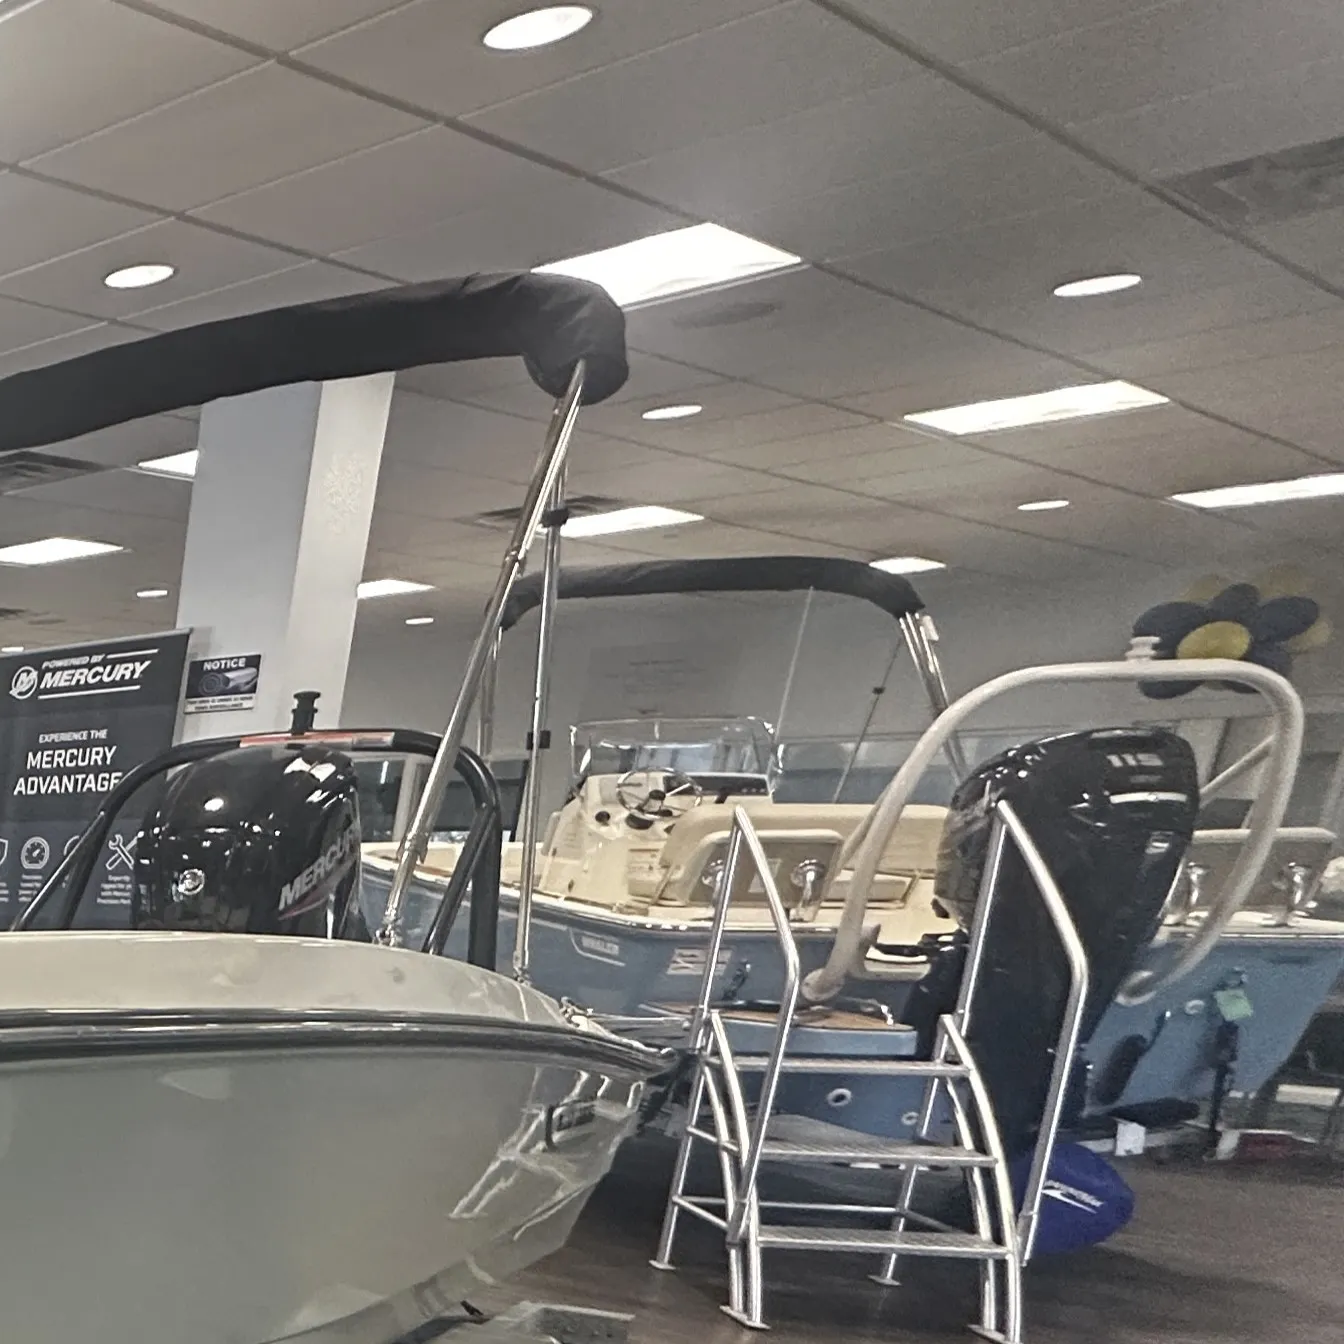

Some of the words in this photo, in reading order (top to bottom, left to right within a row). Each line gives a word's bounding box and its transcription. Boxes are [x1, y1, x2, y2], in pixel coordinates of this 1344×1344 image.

[41, 655, 90, 670] POWERED
[90, 653, 105, 663] BY
[203, 657, 247, 671] NOTICE
[39, 660, 152, 690] MERCURY
[38, 730, 88, 744] EXPERIENCE
[89, 728, 109, 740] THE
[26, 745, 117, 770] MERCURY
[278, 822, 359, 911] MERCUR
